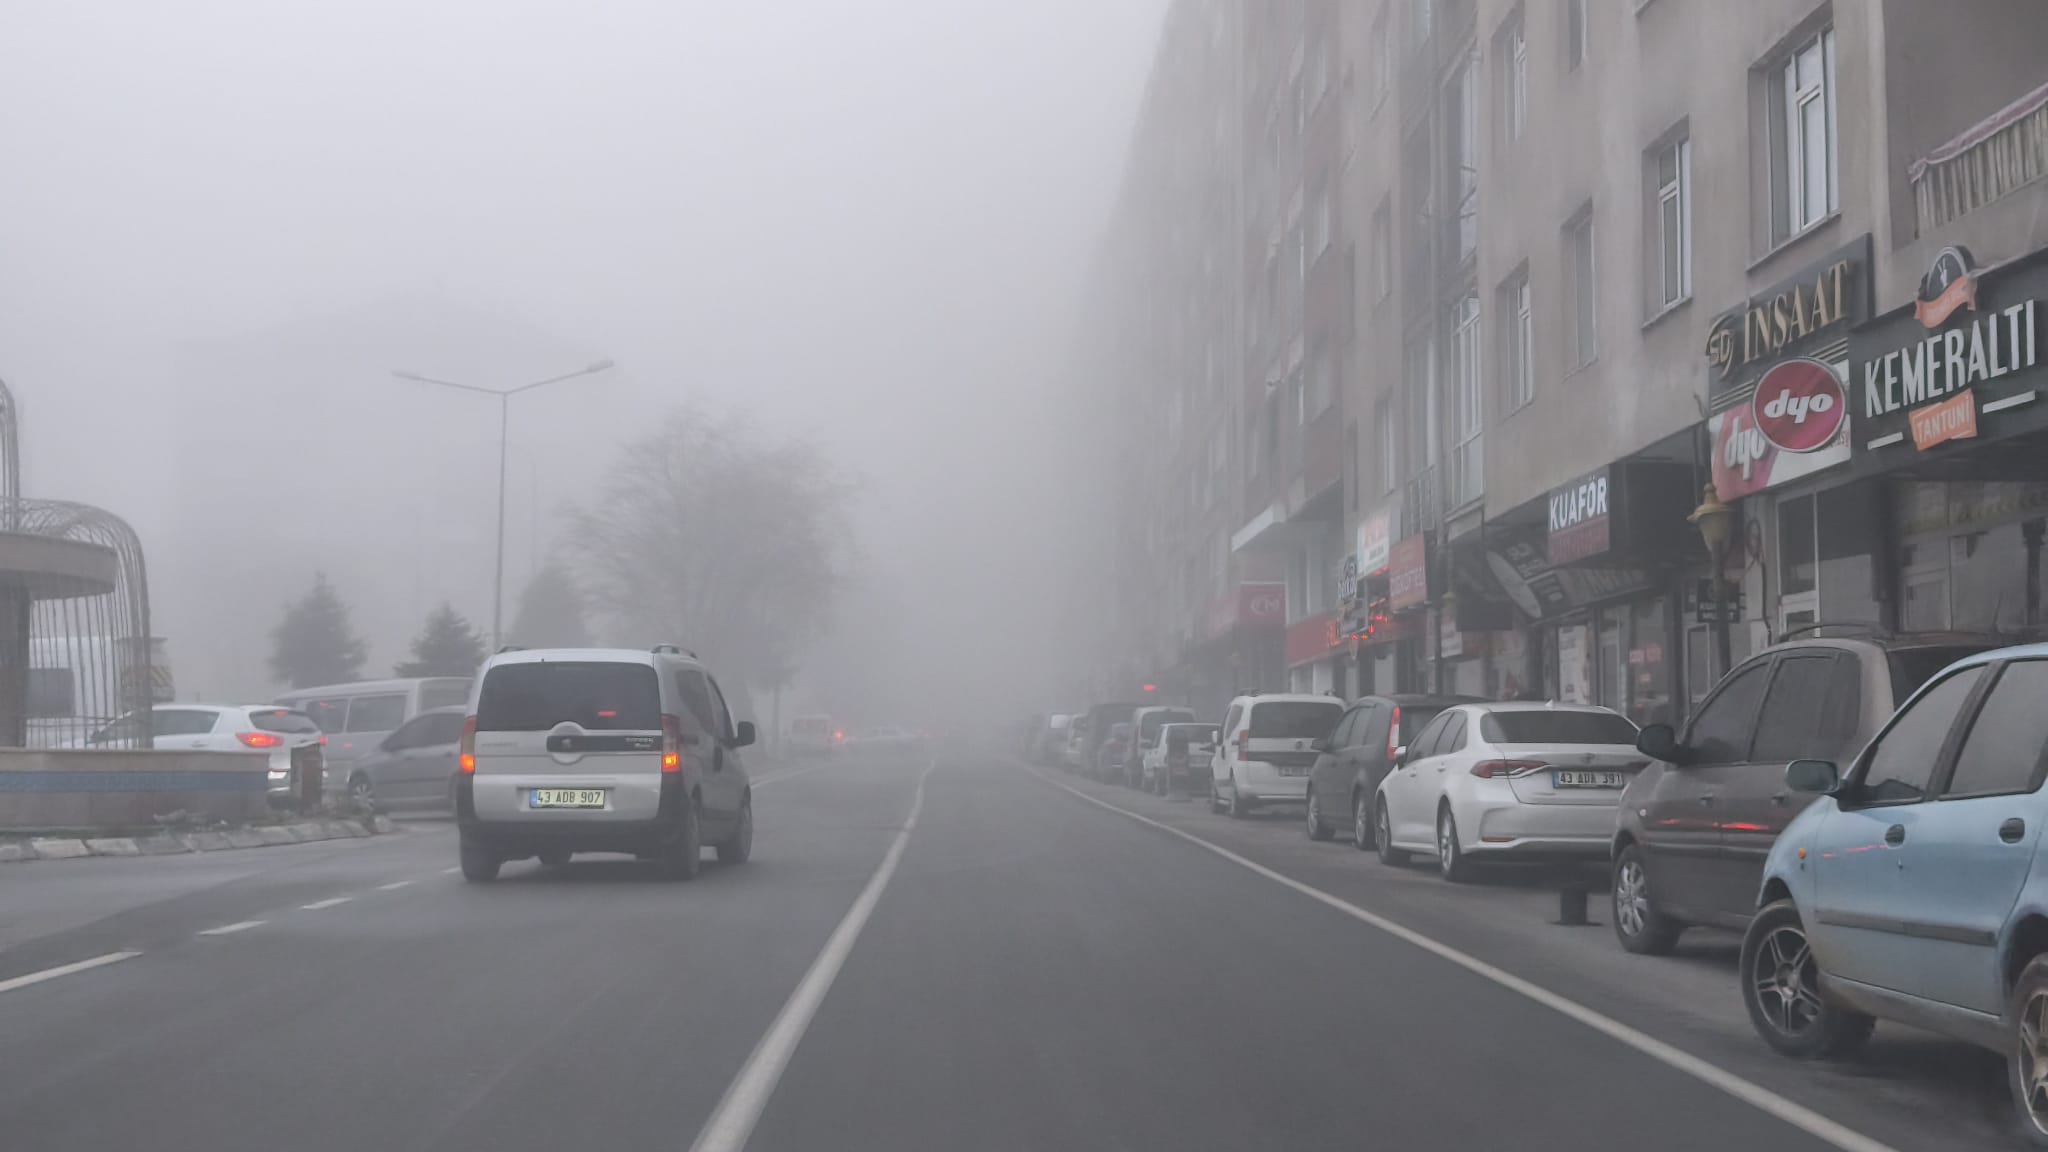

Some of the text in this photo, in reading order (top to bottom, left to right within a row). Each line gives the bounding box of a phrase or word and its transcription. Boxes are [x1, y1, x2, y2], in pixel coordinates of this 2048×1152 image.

[1743, 259, 1848, 364] İNŞAAT
[1864, 299, 2036, 418] KEMERALTI
[1763, 389, 1834, 424] dyo
[1724, 416, 1766, 481] dyo
[1549, 474, 1608, 533] KUAFÖR
[537, 791, 601, 803] 43 ADB 907
[1560, 772, 1573, 784] 43
[1602, 772, 1620, 784] 391
